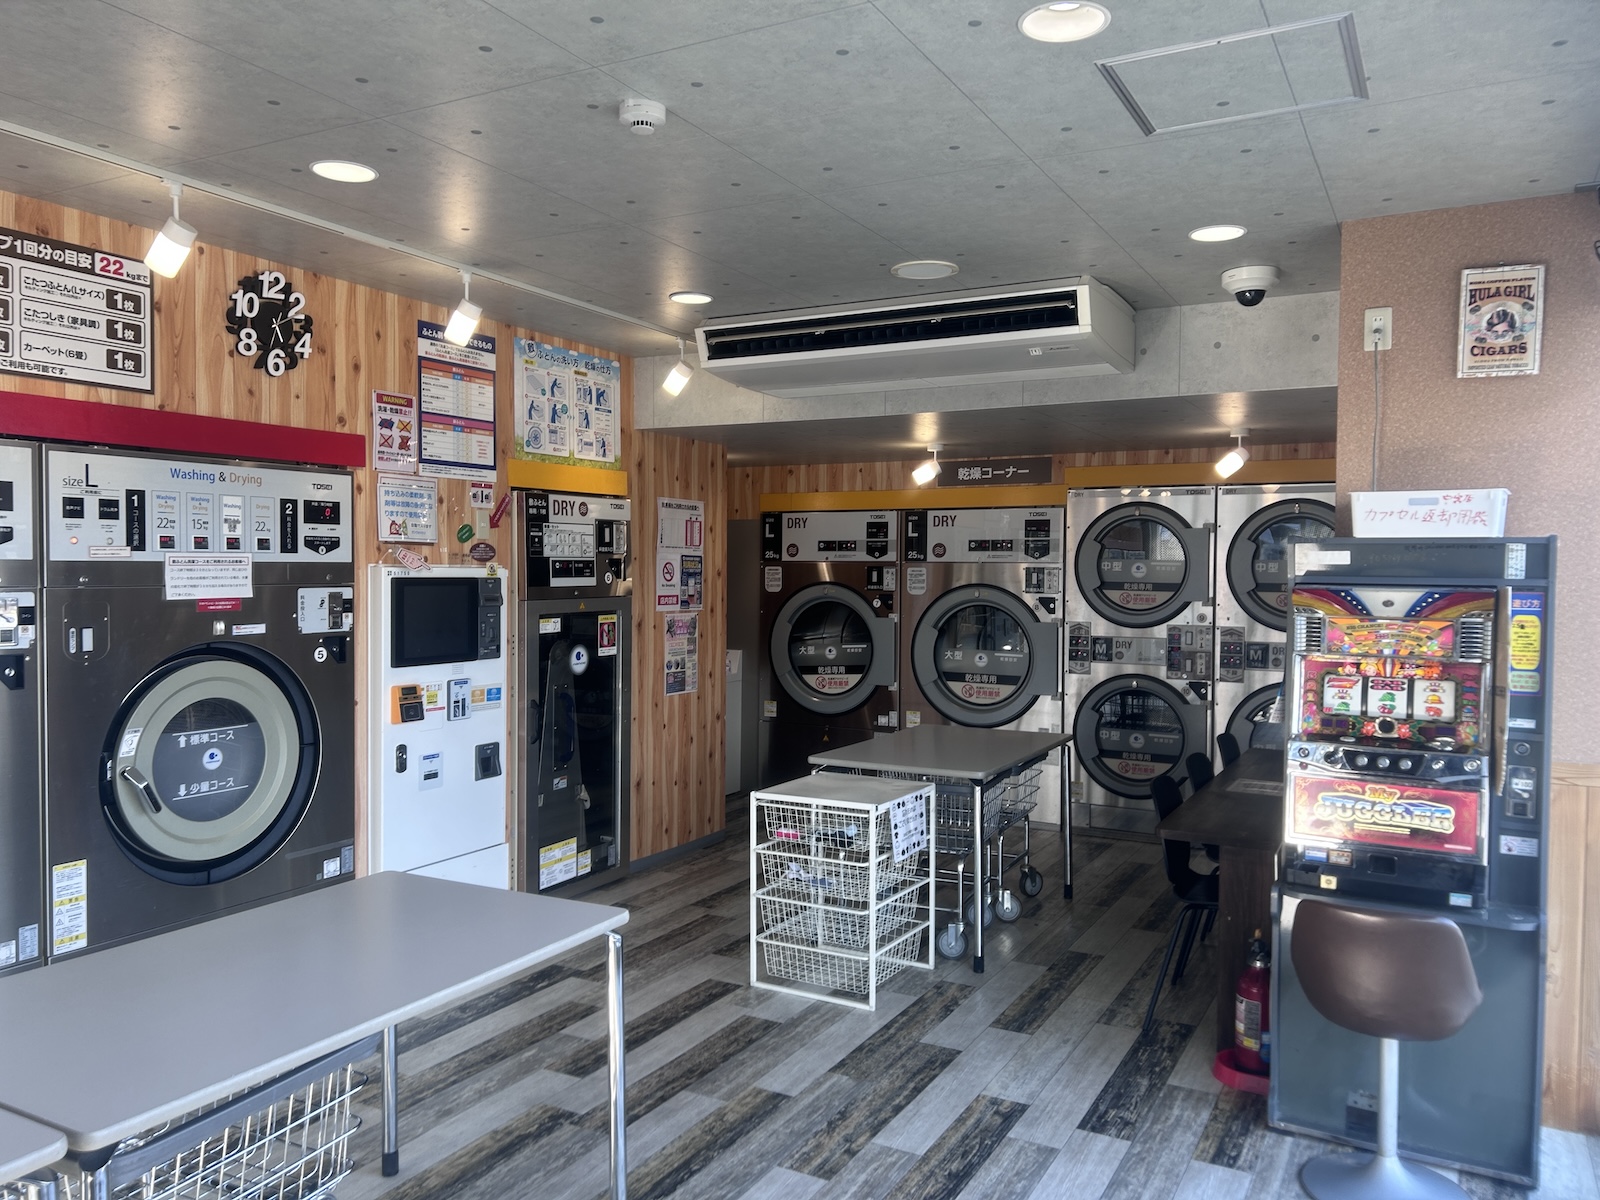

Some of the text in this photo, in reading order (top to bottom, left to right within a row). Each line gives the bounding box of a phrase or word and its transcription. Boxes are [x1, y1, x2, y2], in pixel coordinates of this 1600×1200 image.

[99, 256, 124, 277] 22
[126, 272, 148, 283] kgまで
[258, 270, 286, 300] 12
[113, 292, 135, 312] 1枚
[1468, 284, 1535, 306] HULA GIRL
[231, 289, 260, 318] 10
[287, 292, 306, 320] 2
[113, 321, 135, 341] 1枚
[237, 328, 258, 357] 8
[294, 332, 313, 359] 4
[1470, 342, 1527, 356] CIGARS
[113, 352, 135, 371] 1枚
[266, 348, 286, 377] 6
[382, 395, 408, 405] WARNING
[62, 463, 98, 487] size L
[170, 467, 262, 487] Washing & Drying
[957, 465, 1030, 480] 乾燥コーナー
[131, 494, 138, 507] 1
[156, 494, 177, 502] Washing
[285, 503, 293, 514] 2
[553, 499, 575, 516] DRY
[156, 517, 169, 529] 22
[191, 518, 202, 530] 15
[255, 521, 266, 531] 22
[787, 517, 808, 529] DRY
[933, 515, 956, 527] DRY
[765, 524, 775, 538] L
[908, 522, 918, 537] L
[1101, 561, 1122, 571] 中型
[1255, 562, 1279, 573] 中型
[1512, 599, 1541, 609] 遊び方
[799, 646, 815, 655] 大型
[1095, 644, 1107, 653] M
[1115, 641, 1132, 649] DRY
[1272, 646, 1285, 655] DR
[317, 650, 324, 659] 5
[944, 651, 963, 660] 大型
[1250, 650, 1262, 660] M
[965, 673, 997, 684] 乾燥専用
[189, 730, 235, 746] 標準コース
[1100, 731, 1120, 740] 中型
[189, 778, 235, 794] 少量コース
[1368, 786, 1397, 801] My
[1317, 796, 1453, 831] JUGGLER
